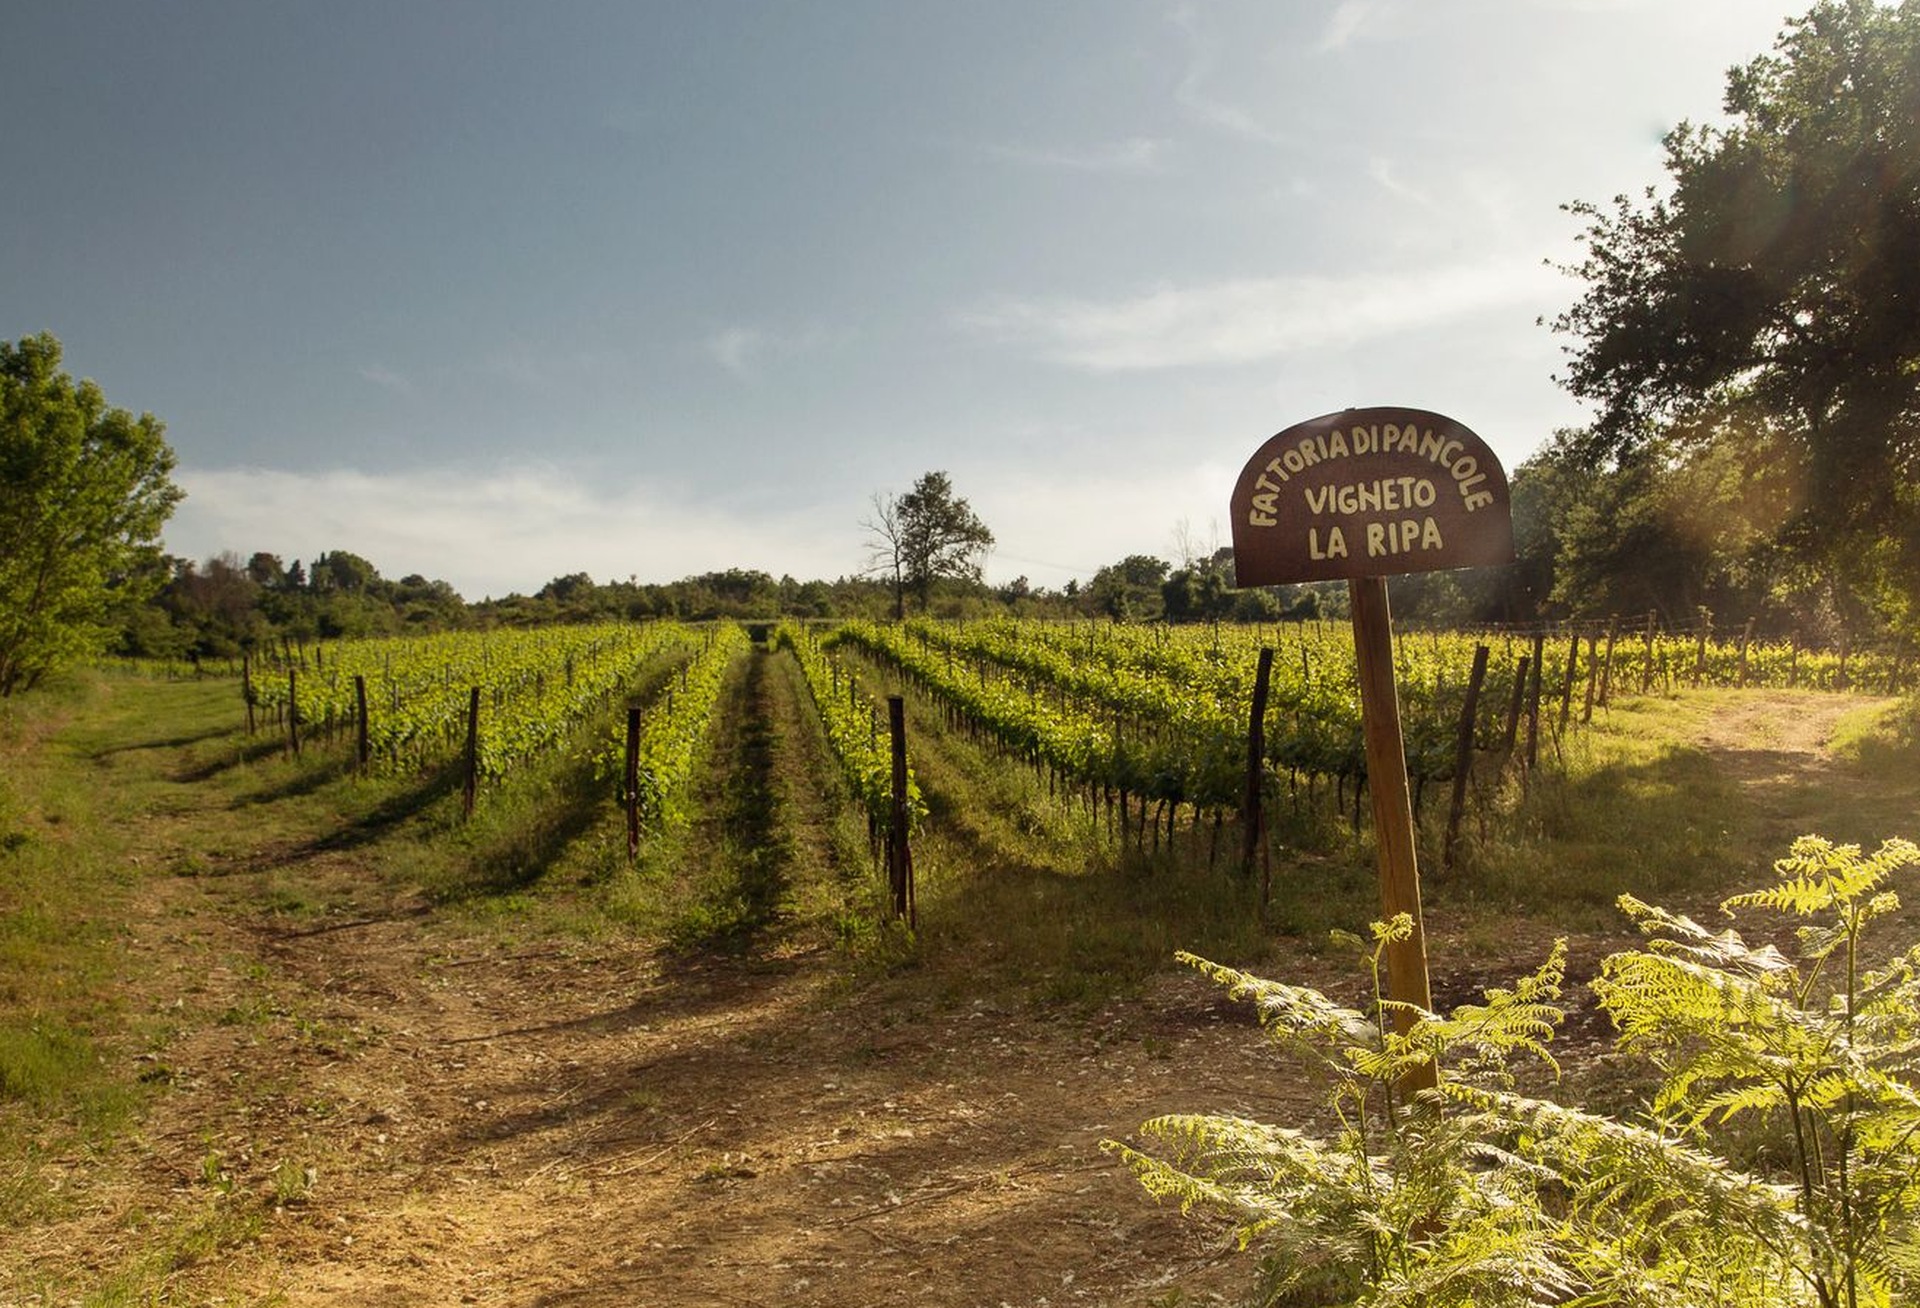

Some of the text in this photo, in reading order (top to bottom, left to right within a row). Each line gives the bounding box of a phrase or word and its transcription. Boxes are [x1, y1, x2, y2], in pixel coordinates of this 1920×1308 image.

[1249, 423, 1494, 527] FATTORIA DI PANCOLE
[1305, 476, 1437, 515] VIGNETO
[1309, 516, 1443, 560] LA RIPA
